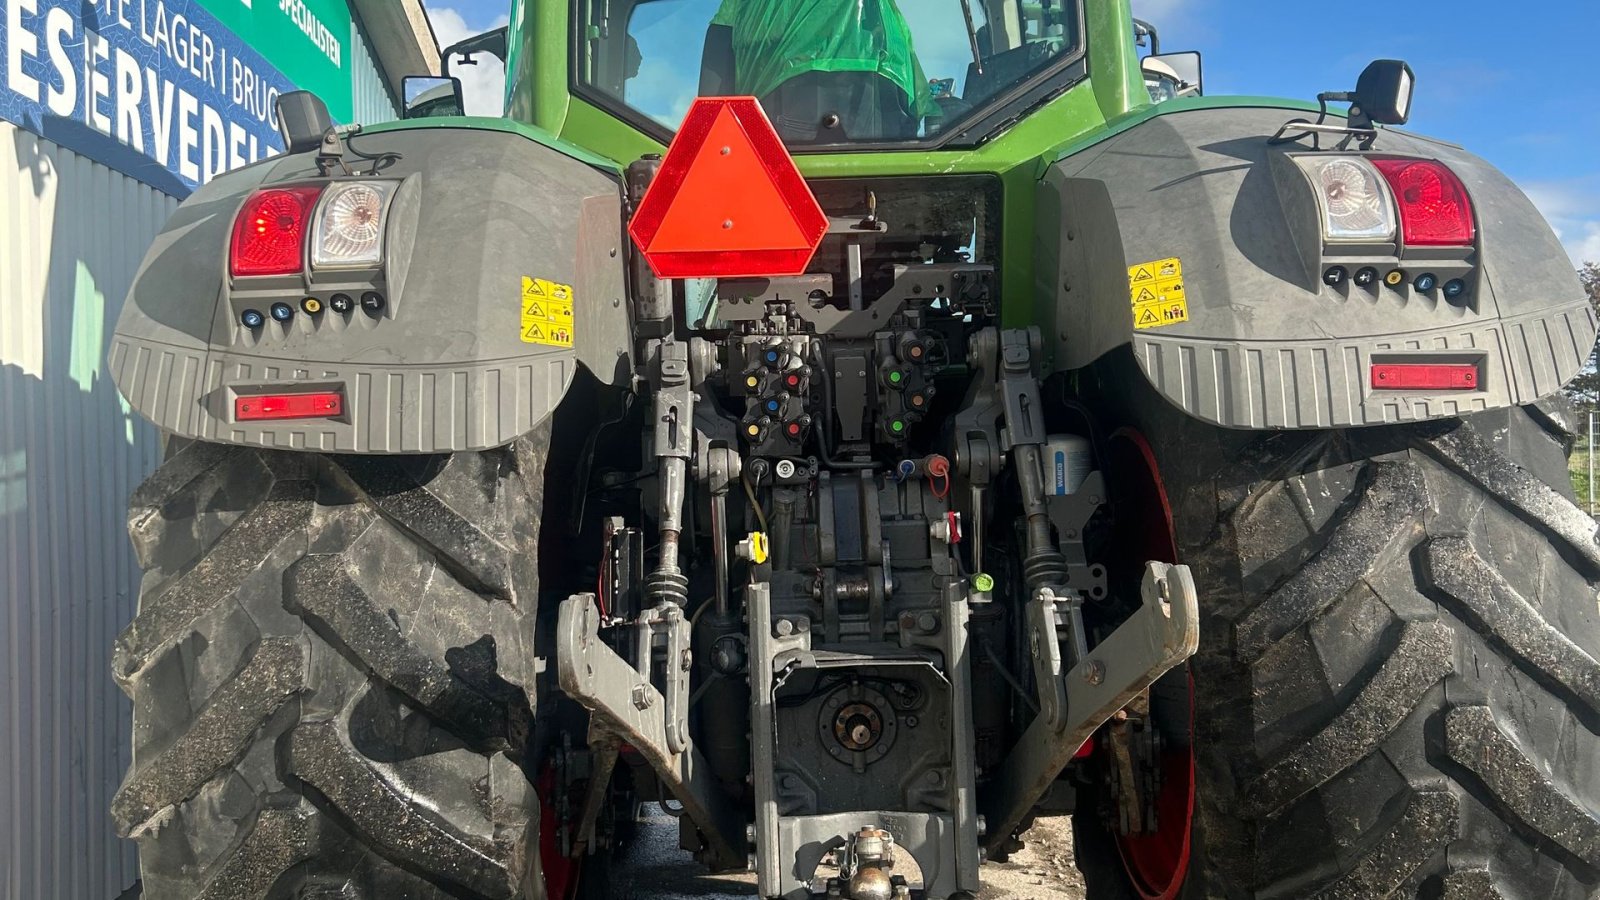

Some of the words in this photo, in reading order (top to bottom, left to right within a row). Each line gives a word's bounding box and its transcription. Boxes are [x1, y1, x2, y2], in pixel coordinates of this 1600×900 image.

[141, 0, 214, 88] LAGER
[221, 47, 226, 95] I
[233, 56, 281, 132] BRUG
